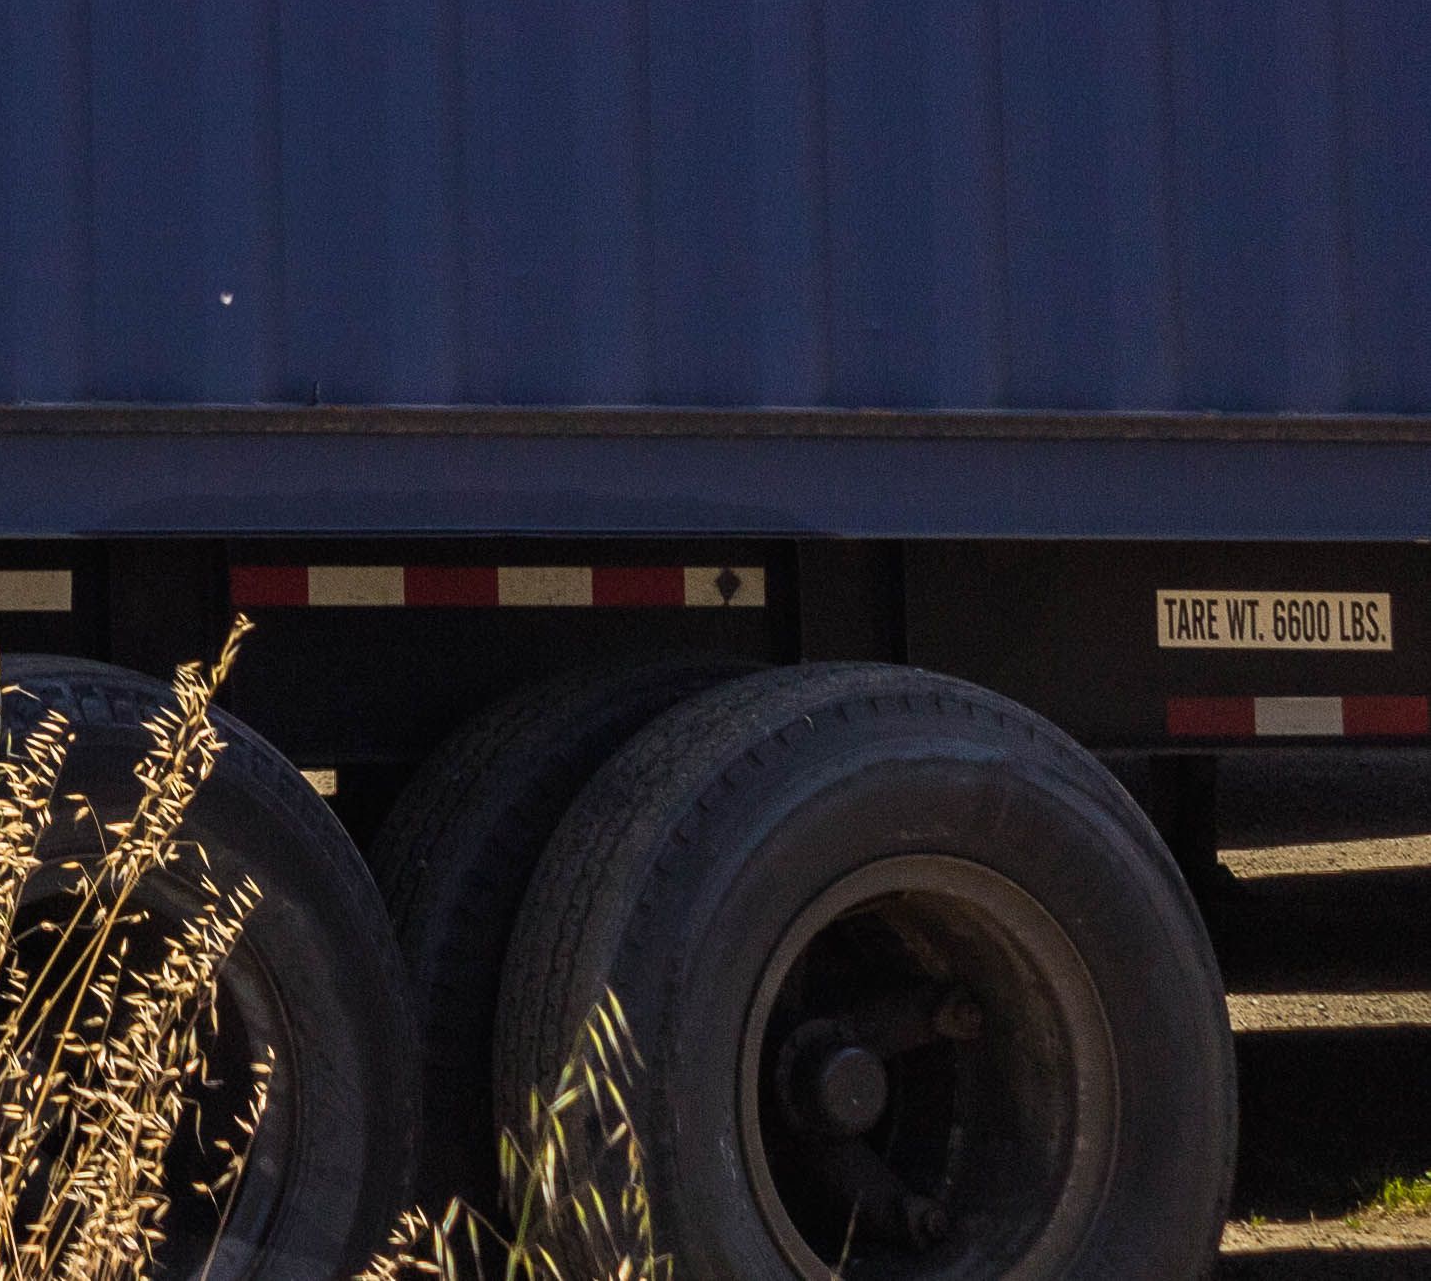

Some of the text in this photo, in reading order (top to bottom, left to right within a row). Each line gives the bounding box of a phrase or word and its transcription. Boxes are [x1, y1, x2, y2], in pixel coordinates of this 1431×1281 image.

[1164, 598, 1387, 643] TARE WT. 6600 LBS.
